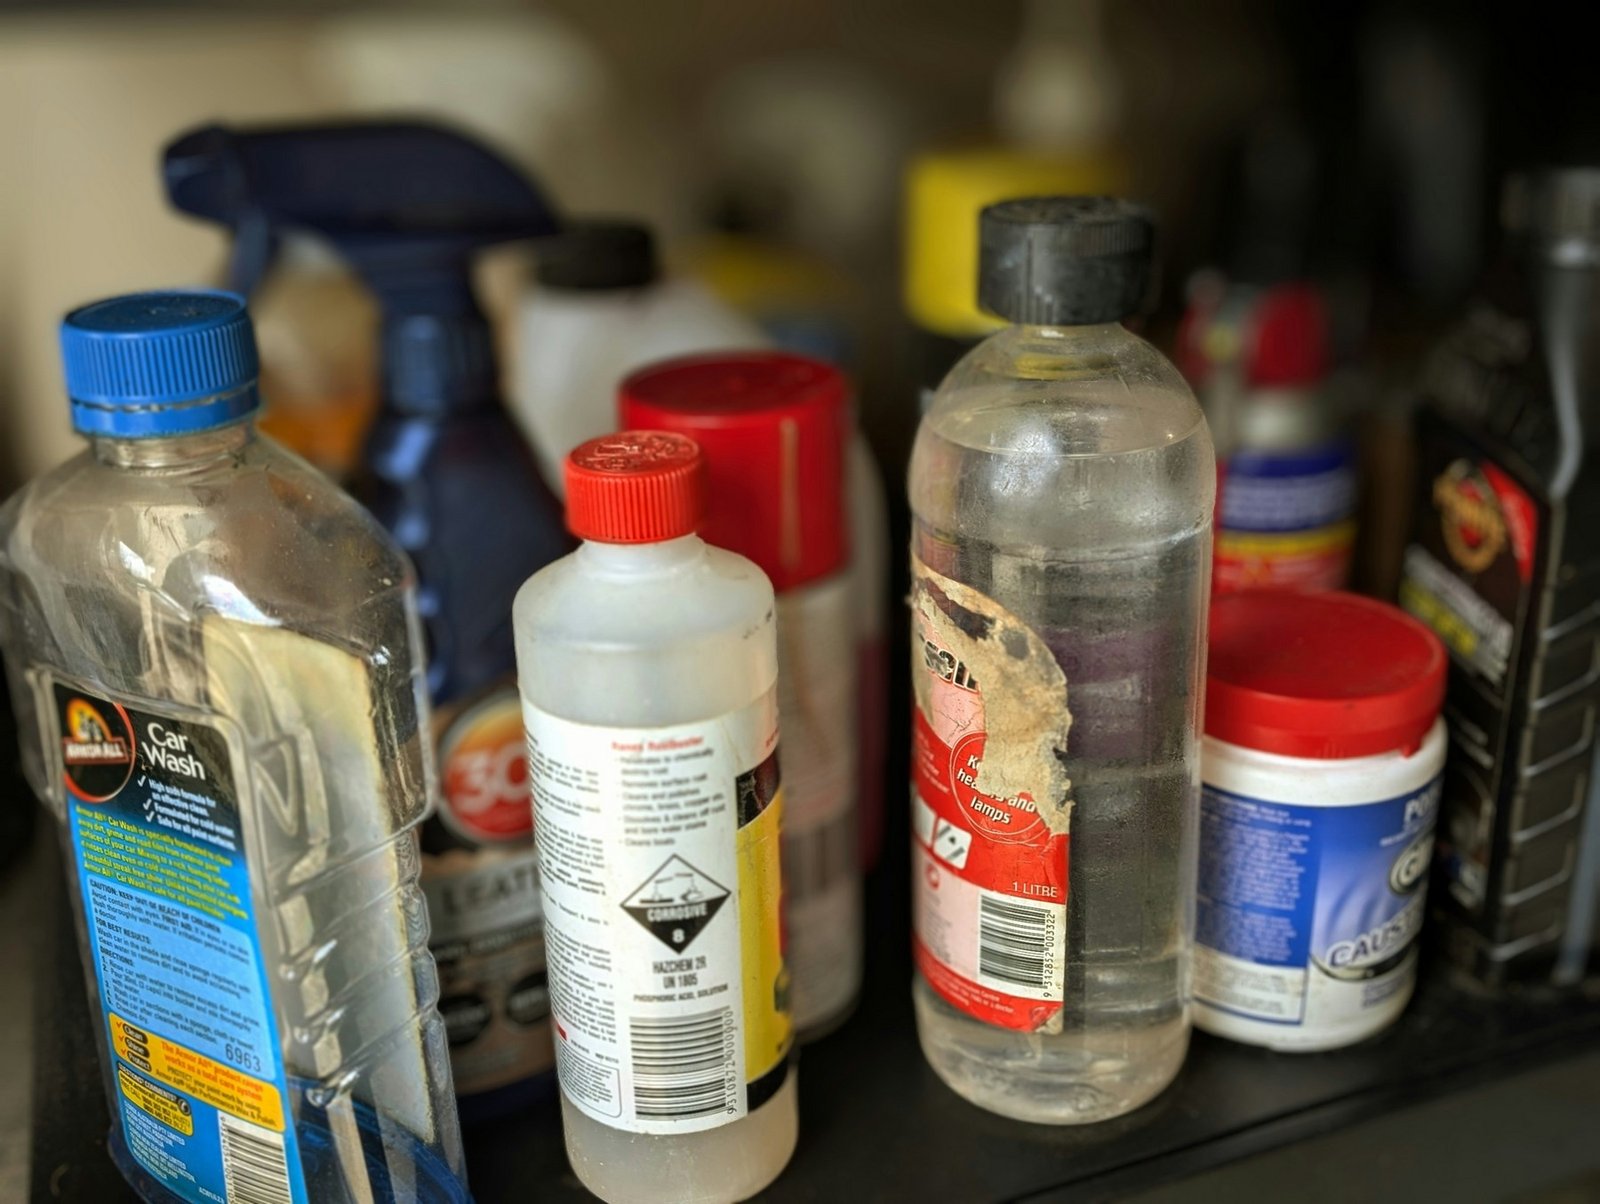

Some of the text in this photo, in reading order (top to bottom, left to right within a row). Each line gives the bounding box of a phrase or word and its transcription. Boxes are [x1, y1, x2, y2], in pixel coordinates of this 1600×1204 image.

[147, 722, 189, 752] Car
[142, 741, 205, 780] Wash
[970, 797, 1011, 824] lamps
[108, 816, 118, 827] Car
[119, 820, 137, 834] Wash
[110, 839, 124, 851] your
[124, 834, 136, 845] and
[116, 872, 126, 883] Car
[127, 876, 145, 890] Wash
[1012, 881, 1018, 892] 1
[108, 895, 130, 909] contact
[118, 889, 132, 902] KEEP
[647, 903, 708, 922] CORROSIVE
[96, 916, 106, 927] FOR
[107, 920, 122, 933] BEST
[1045, 913, 1055, 947] 003322
[97, 927, 112, 939] Wash
[113, 933, 122, 943] car
[672, 928, 686, 944] 8
[124, 964, 134, 975] car
[652, 958, 693, 975] HAZCHEM
[1044, 952, 1054, 986] 312852
[663, 972, 698, 989] UN 1805
[633, 994, 677, 1003] PHOSPHORIC
[697, 983, 729, 998] SOLUTION
[124, 1025, 142, 1041] Clean
[128, 1050, 150, 1069] Protect
[225, 1041, 260, 1073] 6963
